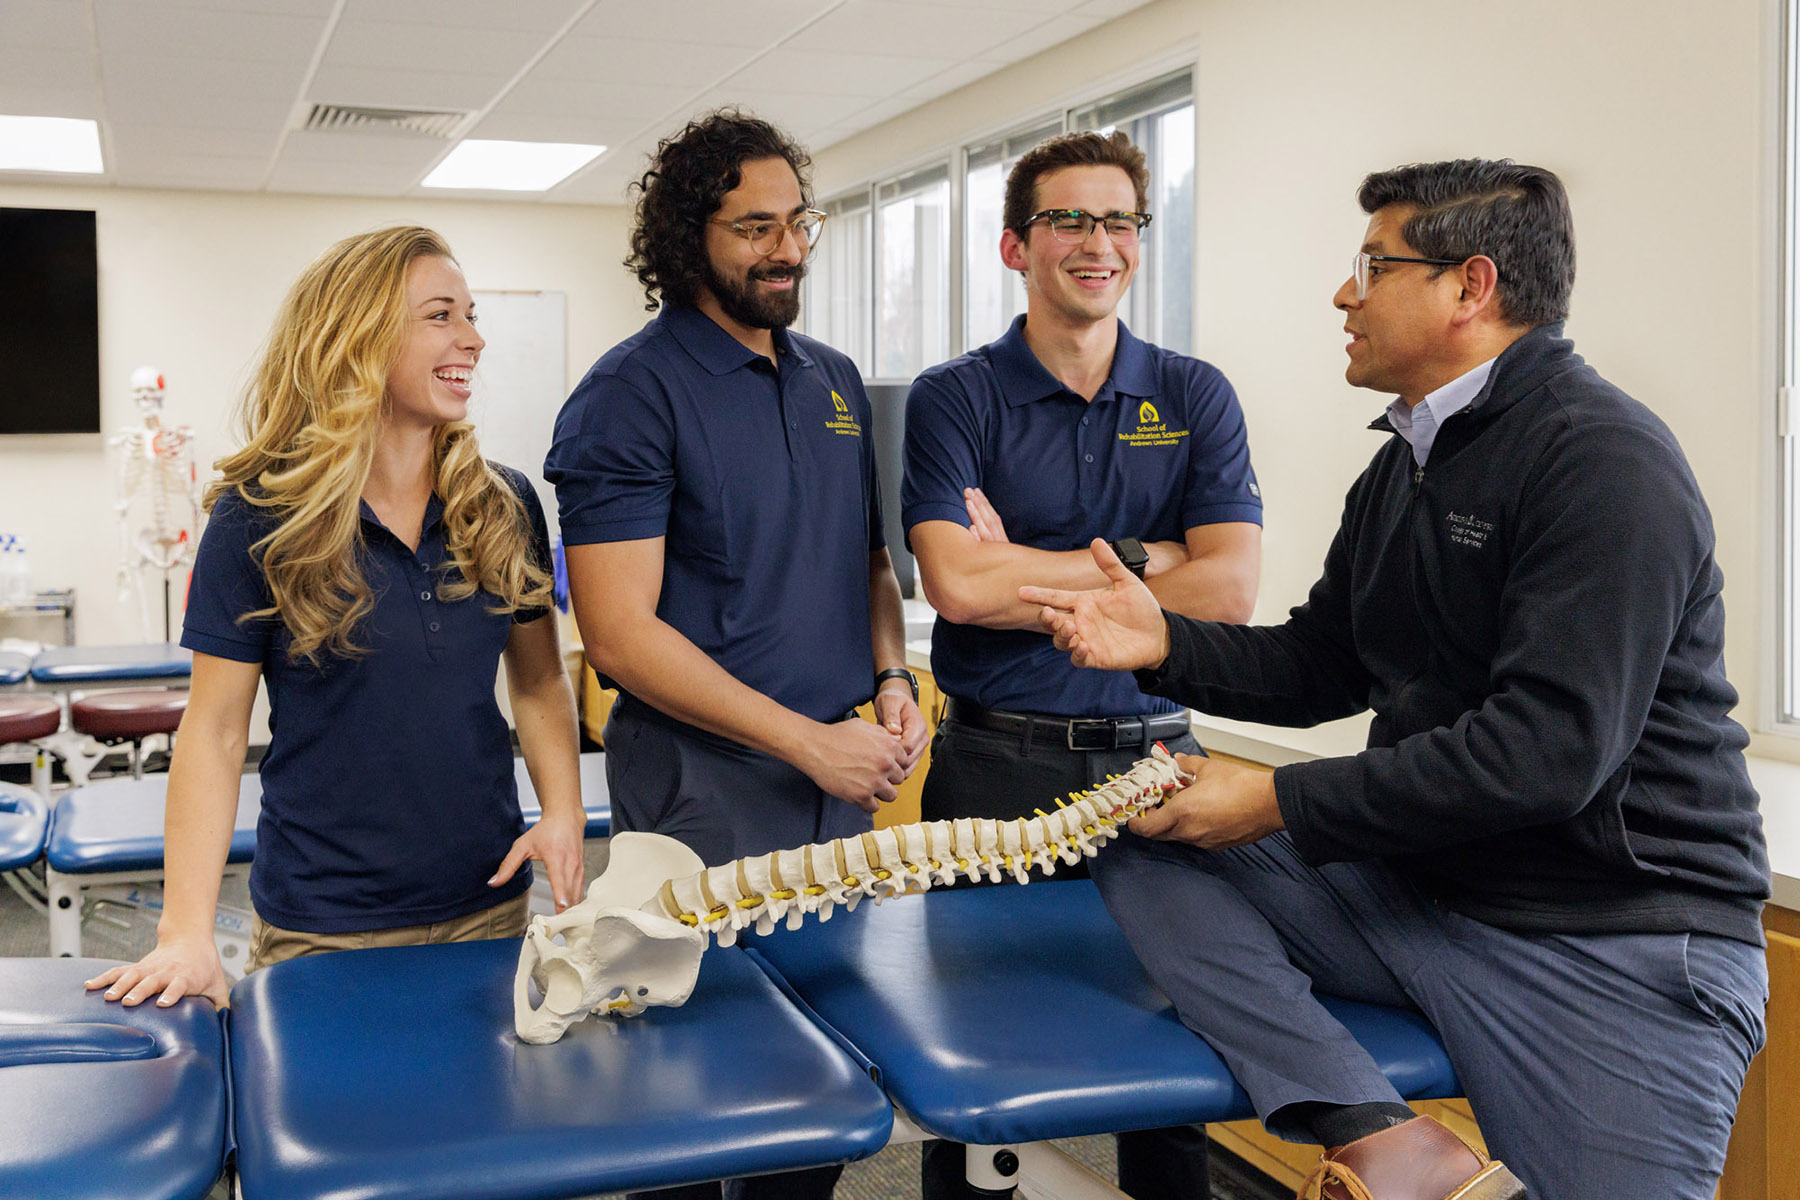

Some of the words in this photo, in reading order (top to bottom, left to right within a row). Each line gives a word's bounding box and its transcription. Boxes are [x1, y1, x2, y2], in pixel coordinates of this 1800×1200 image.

[1136, 424, 1158, 432] School
[1159, 423, 1166, 431] of
[1162, 430, 1189, 438] Sciences
